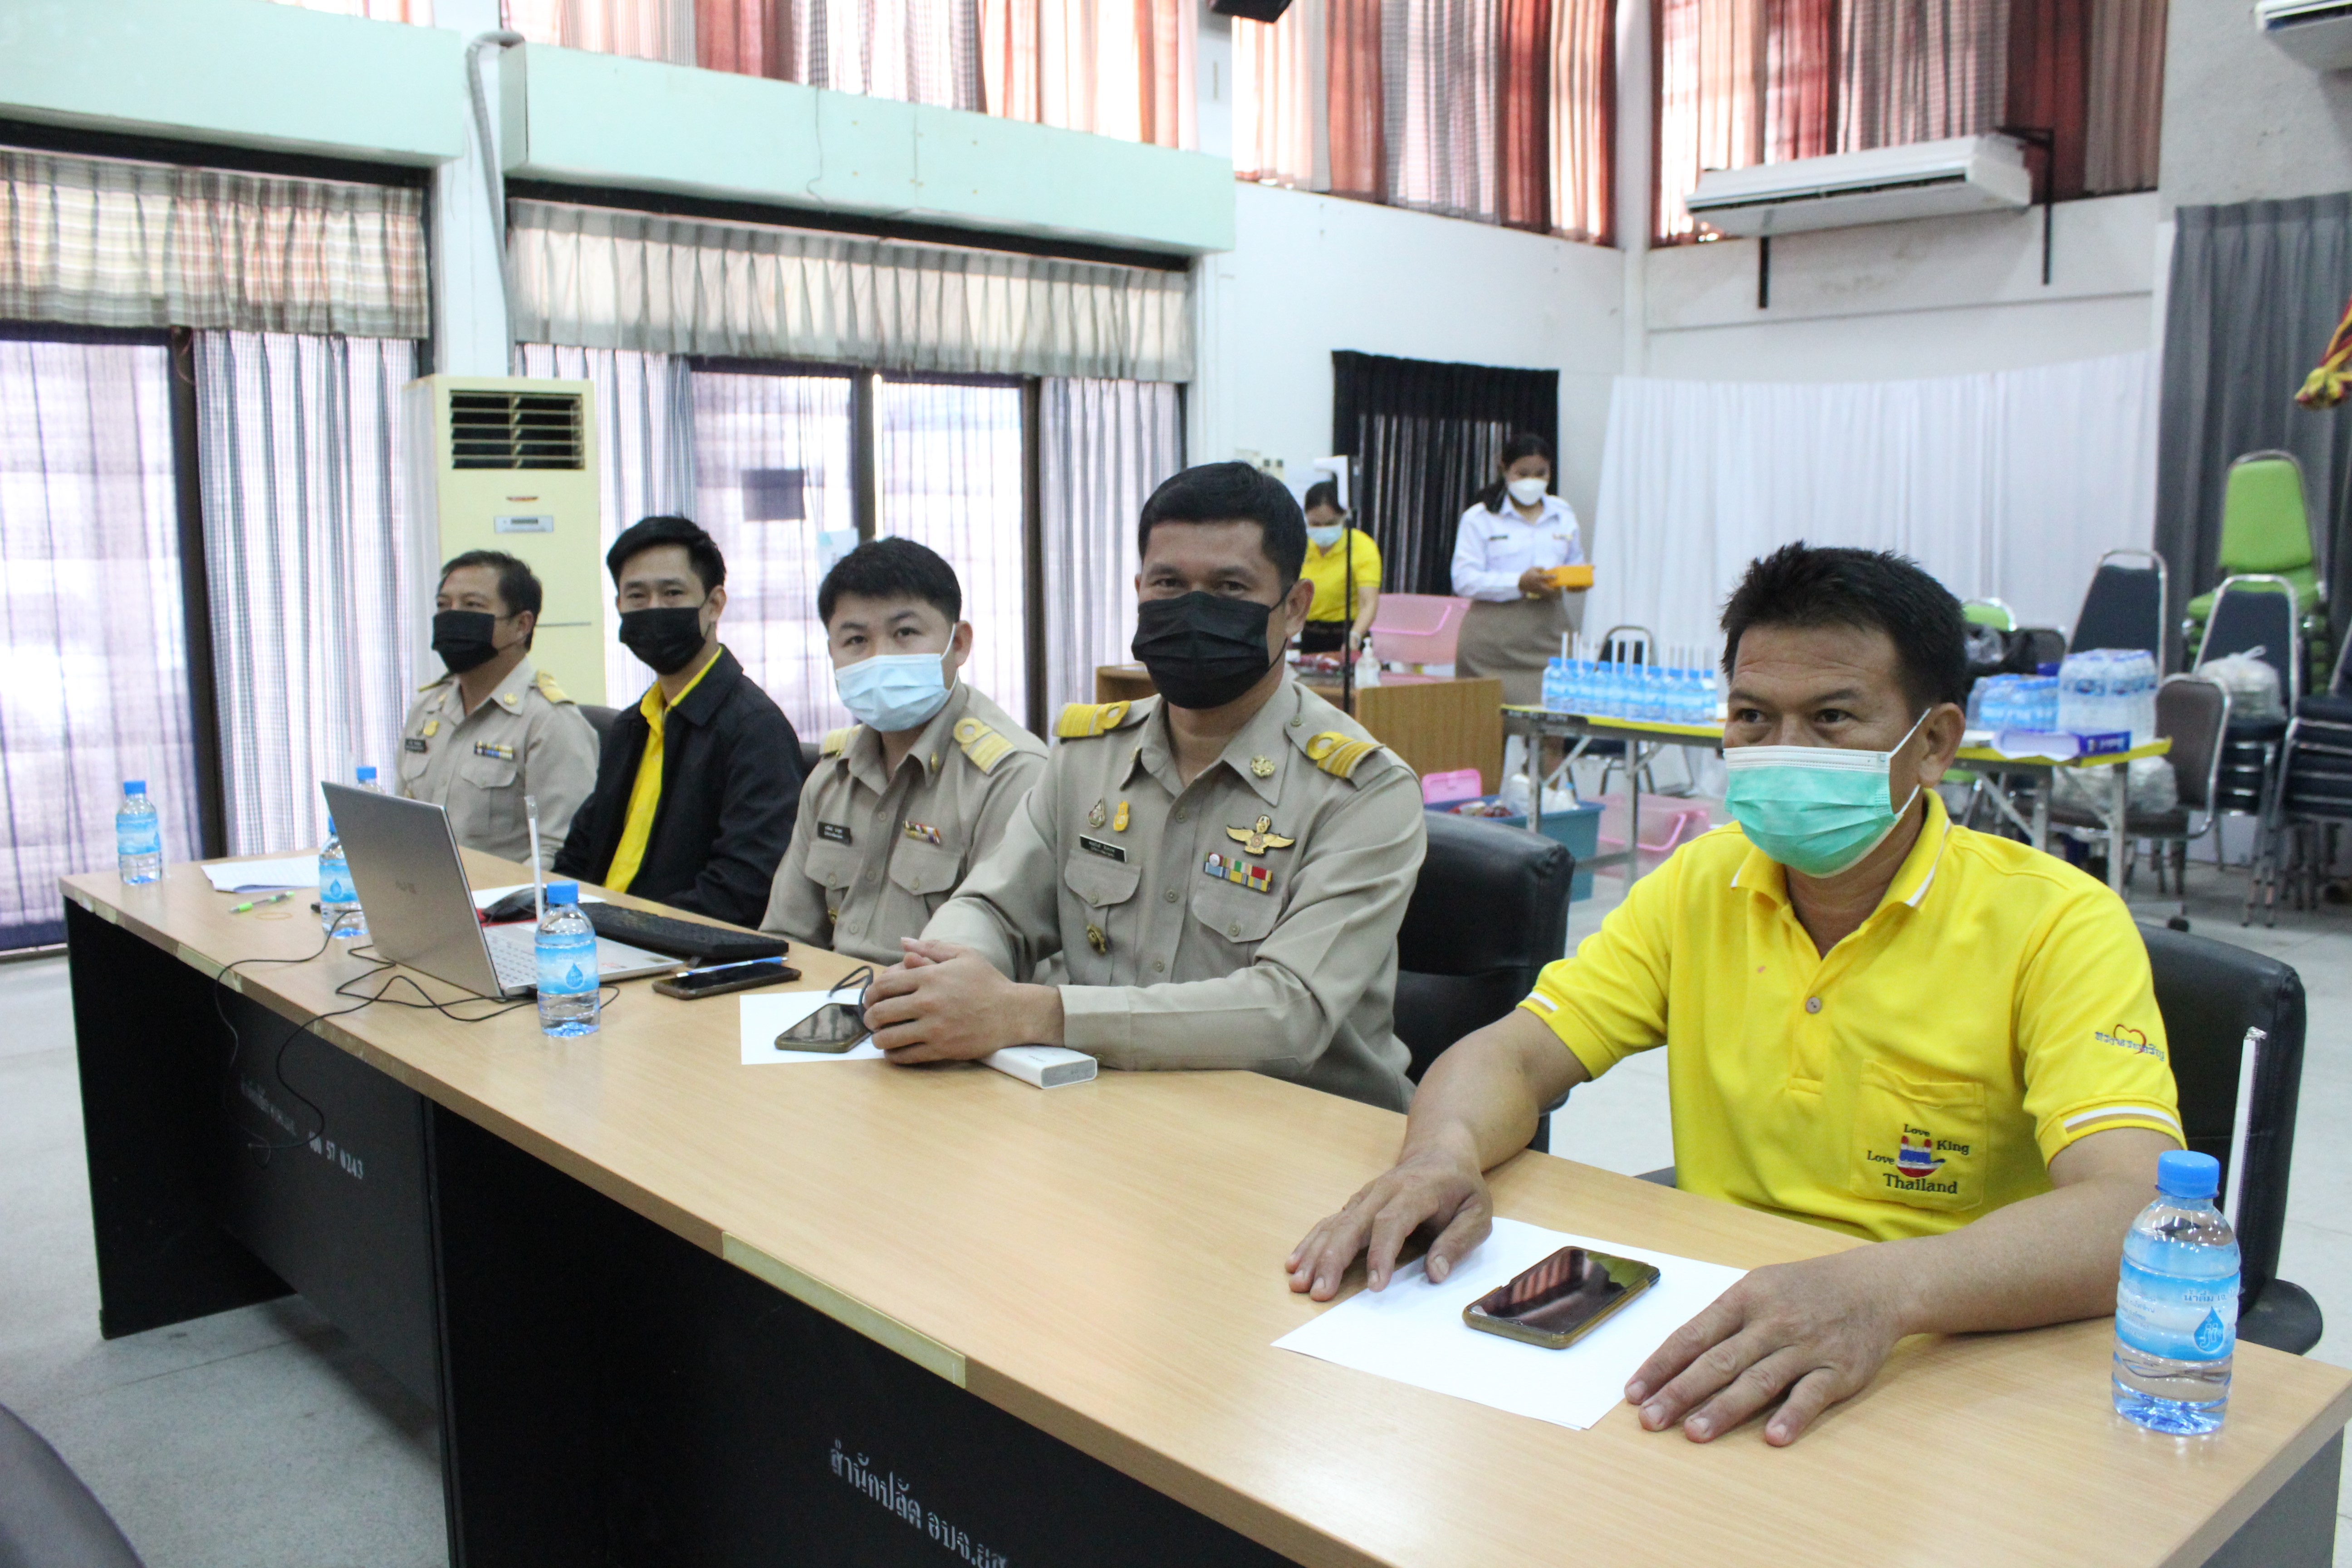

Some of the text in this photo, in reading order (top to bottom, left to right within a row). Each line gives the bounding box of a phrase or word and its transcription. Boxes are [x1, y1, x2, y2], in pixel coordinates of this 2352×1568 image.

[1904, 1124, 1930, 1137] Love
[1936, 1140, 1970, 1155] King
[1867, 1151, 1895, 1165] Love
[1883, 1173, 1957, 1194] Thailand
[2184, 1289, 2214, 1302] น้ำดื่ม
